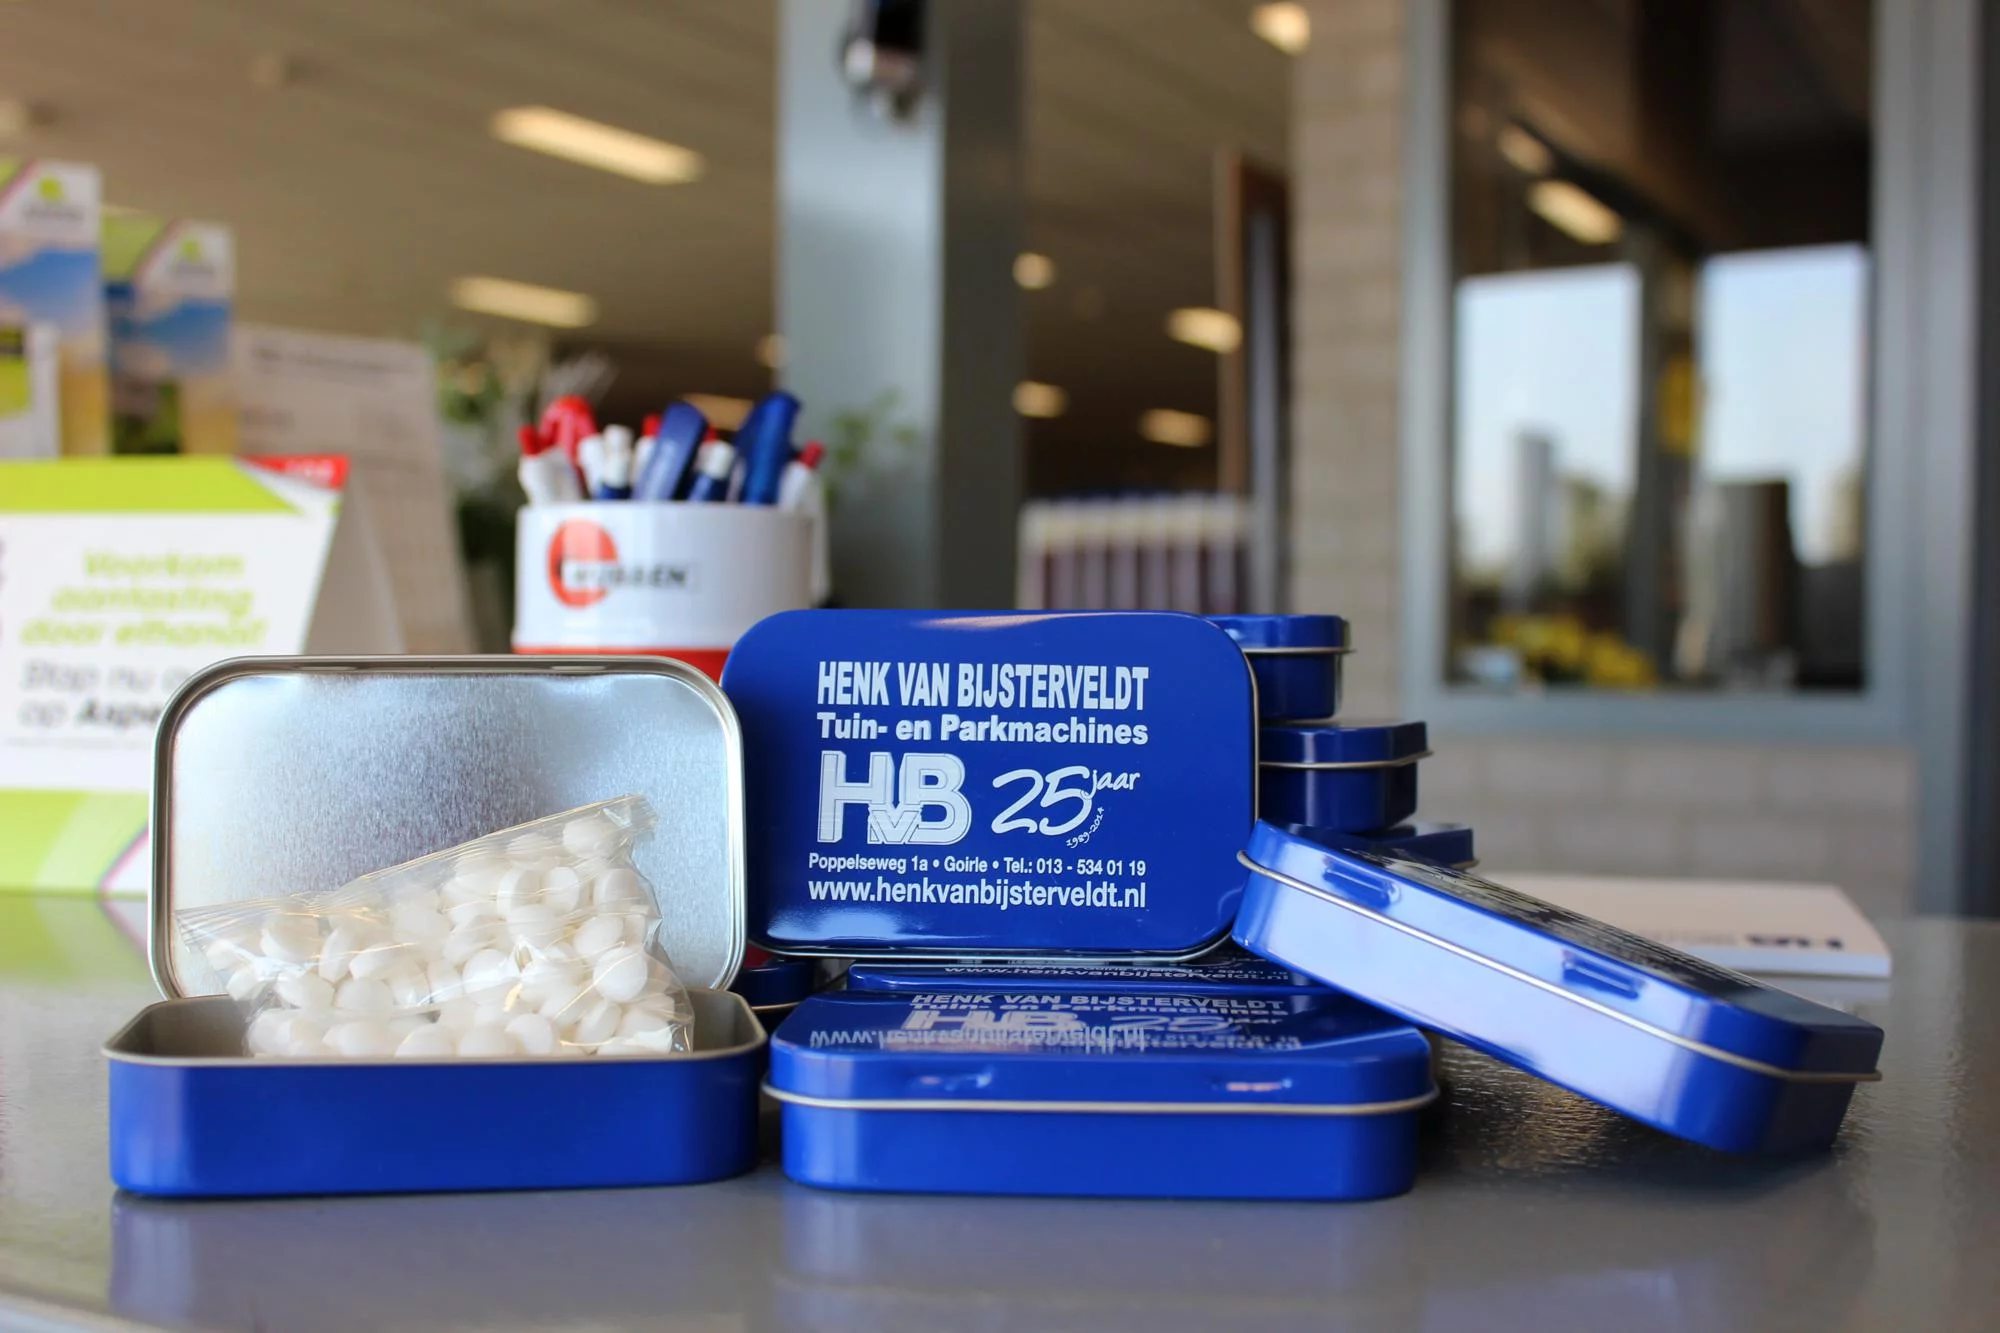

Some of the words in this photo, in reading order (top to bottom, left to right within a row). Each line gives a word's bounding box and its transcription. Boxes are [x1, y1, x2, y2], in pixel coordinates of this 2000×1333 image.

[84, 550, 245, 577] Voorkom
[817, 660, 891, 706] HENK
[898, 662, 950, 707] VAN
[957, 663, 1149, 710] BIJSTERVELDT
[817, 712, 888, 740] Tuin-
[895, 718, 932, 741] en
[941, 713, 1149, 745] Parkmachines
[991, 765, 1093, 836] 25
[1081, 769, 1141, 800] jaar
[1065, 806, 1105, 849] 1989-2014
[808, 853, 907, 873] Poppelseweg
[911, 855, 928, 871] 1a
[944, 856, 988, 873] Goirle
[1003, 857, 1033, 874] Tel.:
[1036, 858, 1061, 875] 013
[1076, 858, 1103, 875] 534
[1106, 859, 1124, 876] 01
[1128, 859, 1146, 877] 19
[808, 876, 1146, 910] www.henkvanbijsterveldt.nl
[912, 994, 994, 1004] HENK
[1003, 995, 1061, 1004] VAN
[1071, 995, 1285, 1010] BIJSTERVELDT
